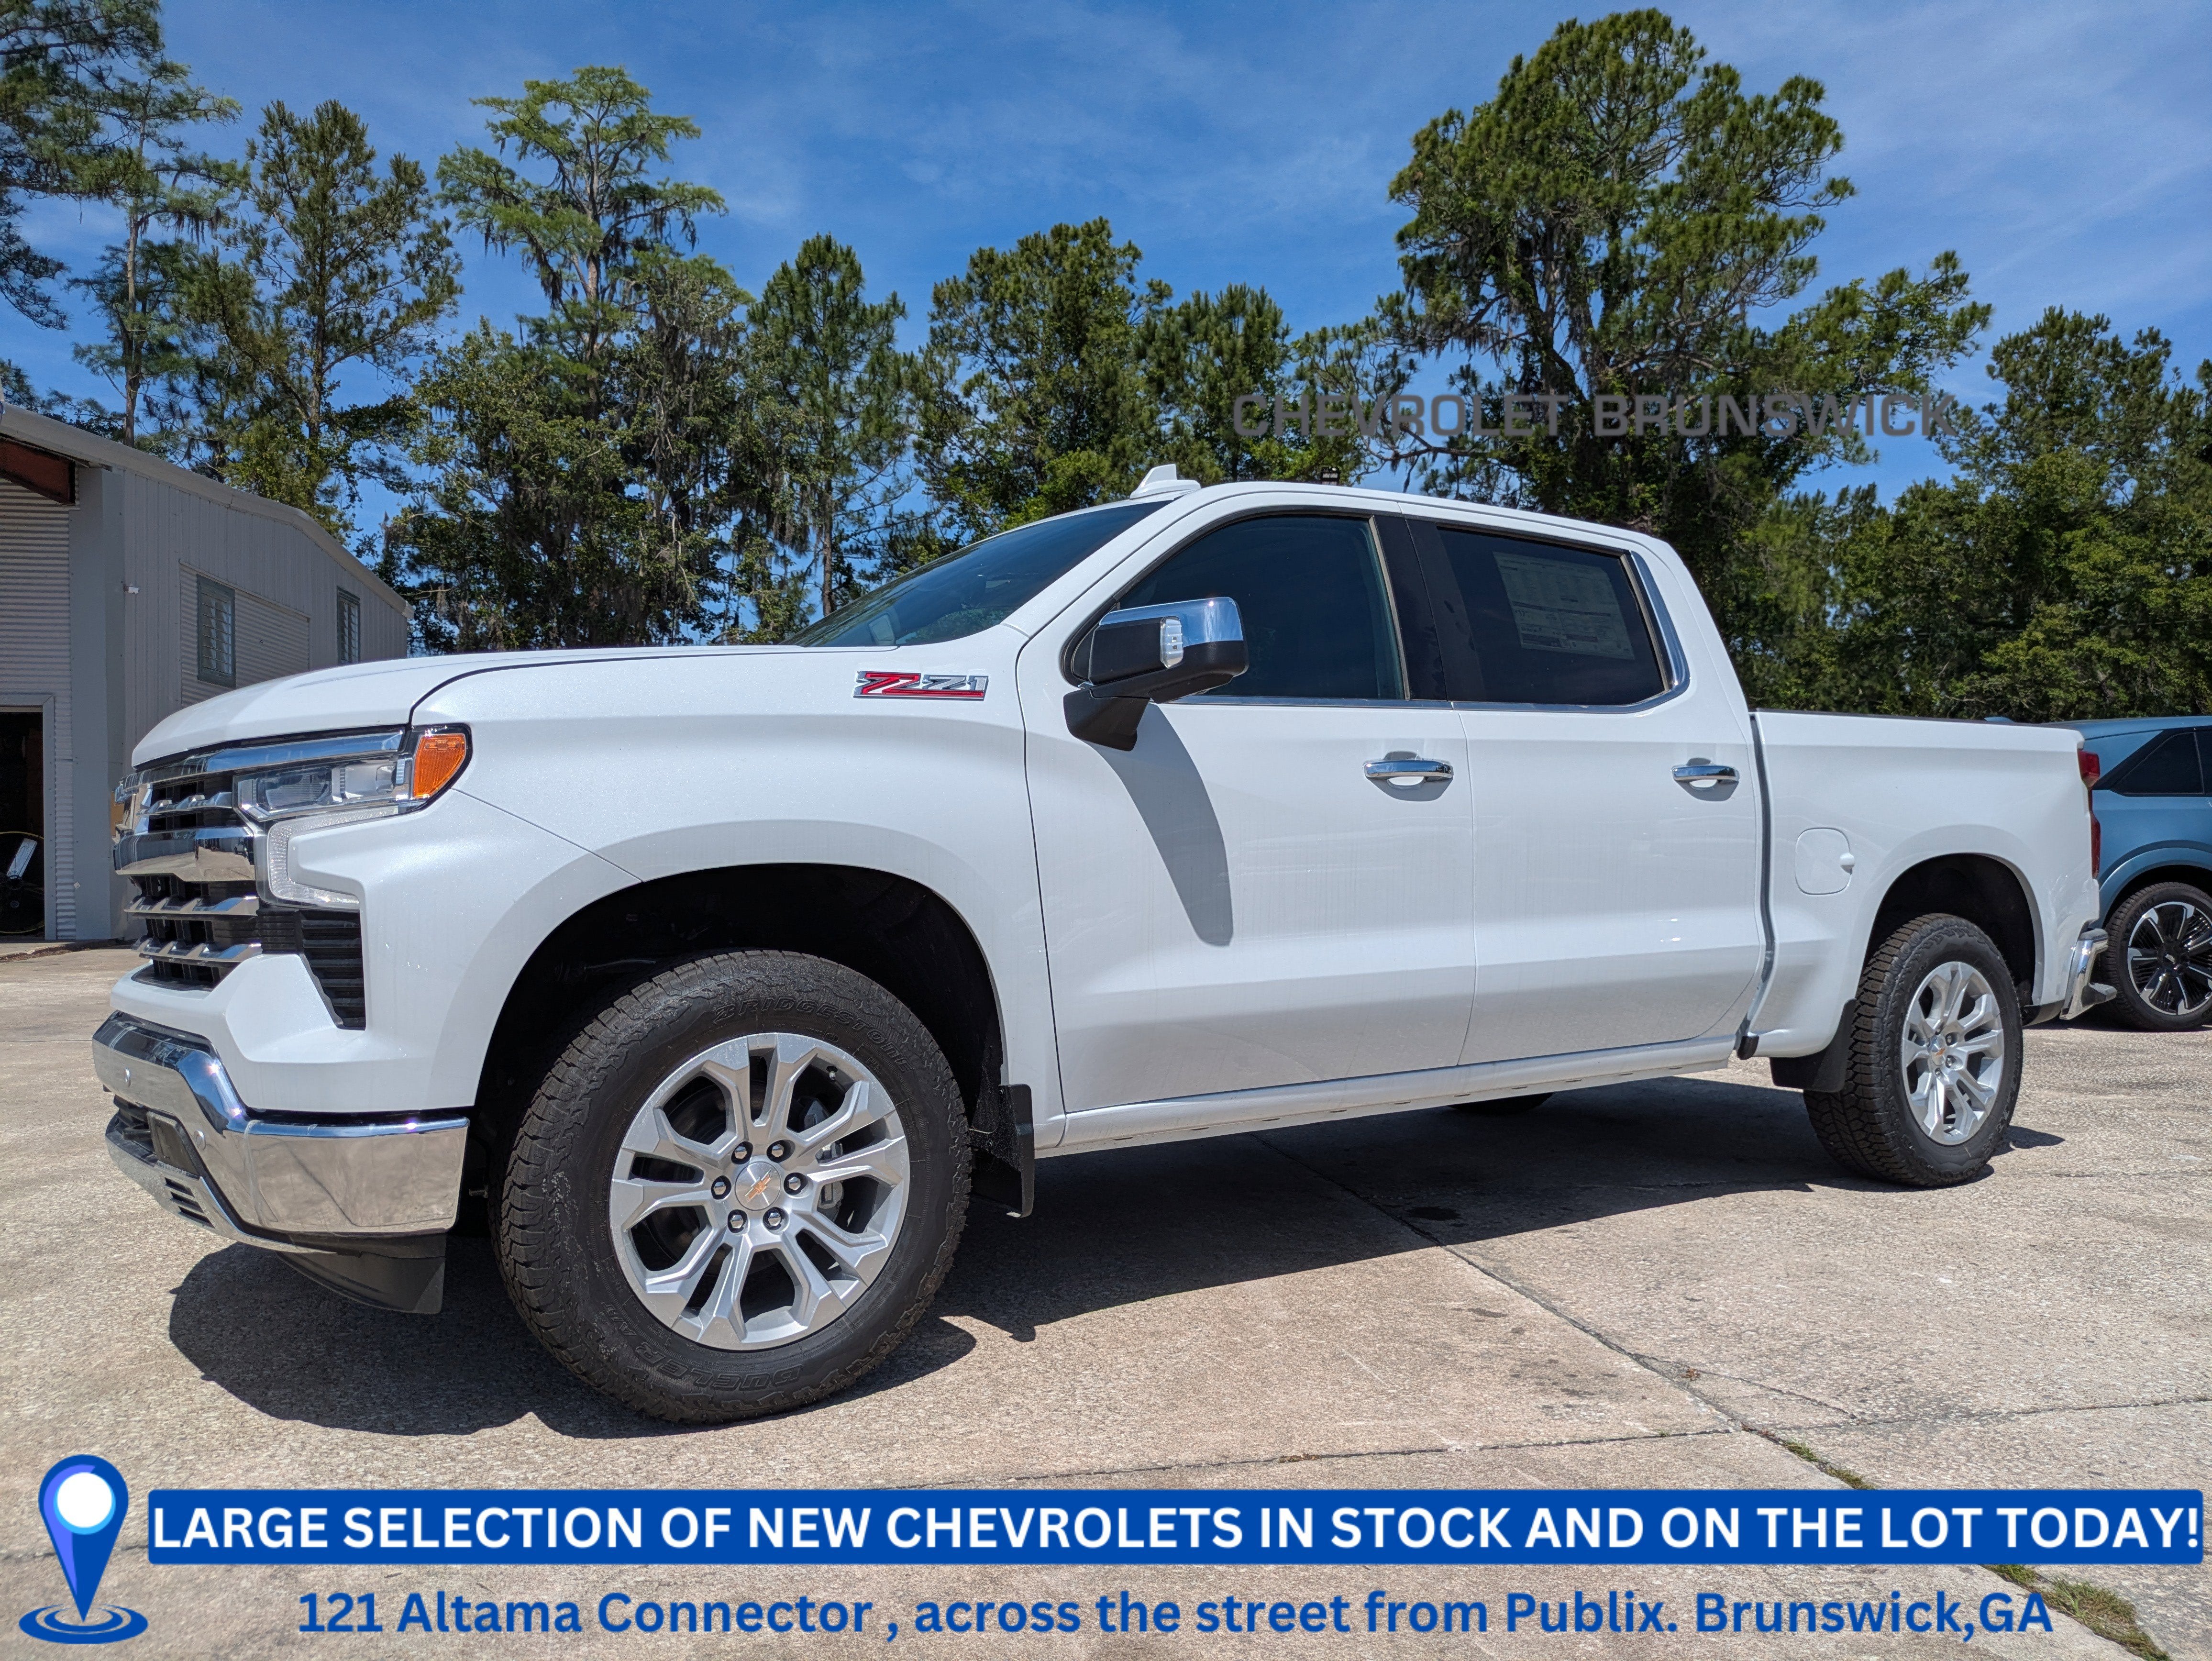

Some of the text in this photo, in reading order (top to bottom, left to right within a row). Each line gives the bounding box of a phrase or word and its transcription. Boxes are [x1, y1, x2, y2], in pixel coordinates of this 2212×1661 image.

[853, 671, 989, 701] Z71
[712, 997, 915, 1073] BRIDGESTONE
[634, 1342, 802, 1391] DUELER
